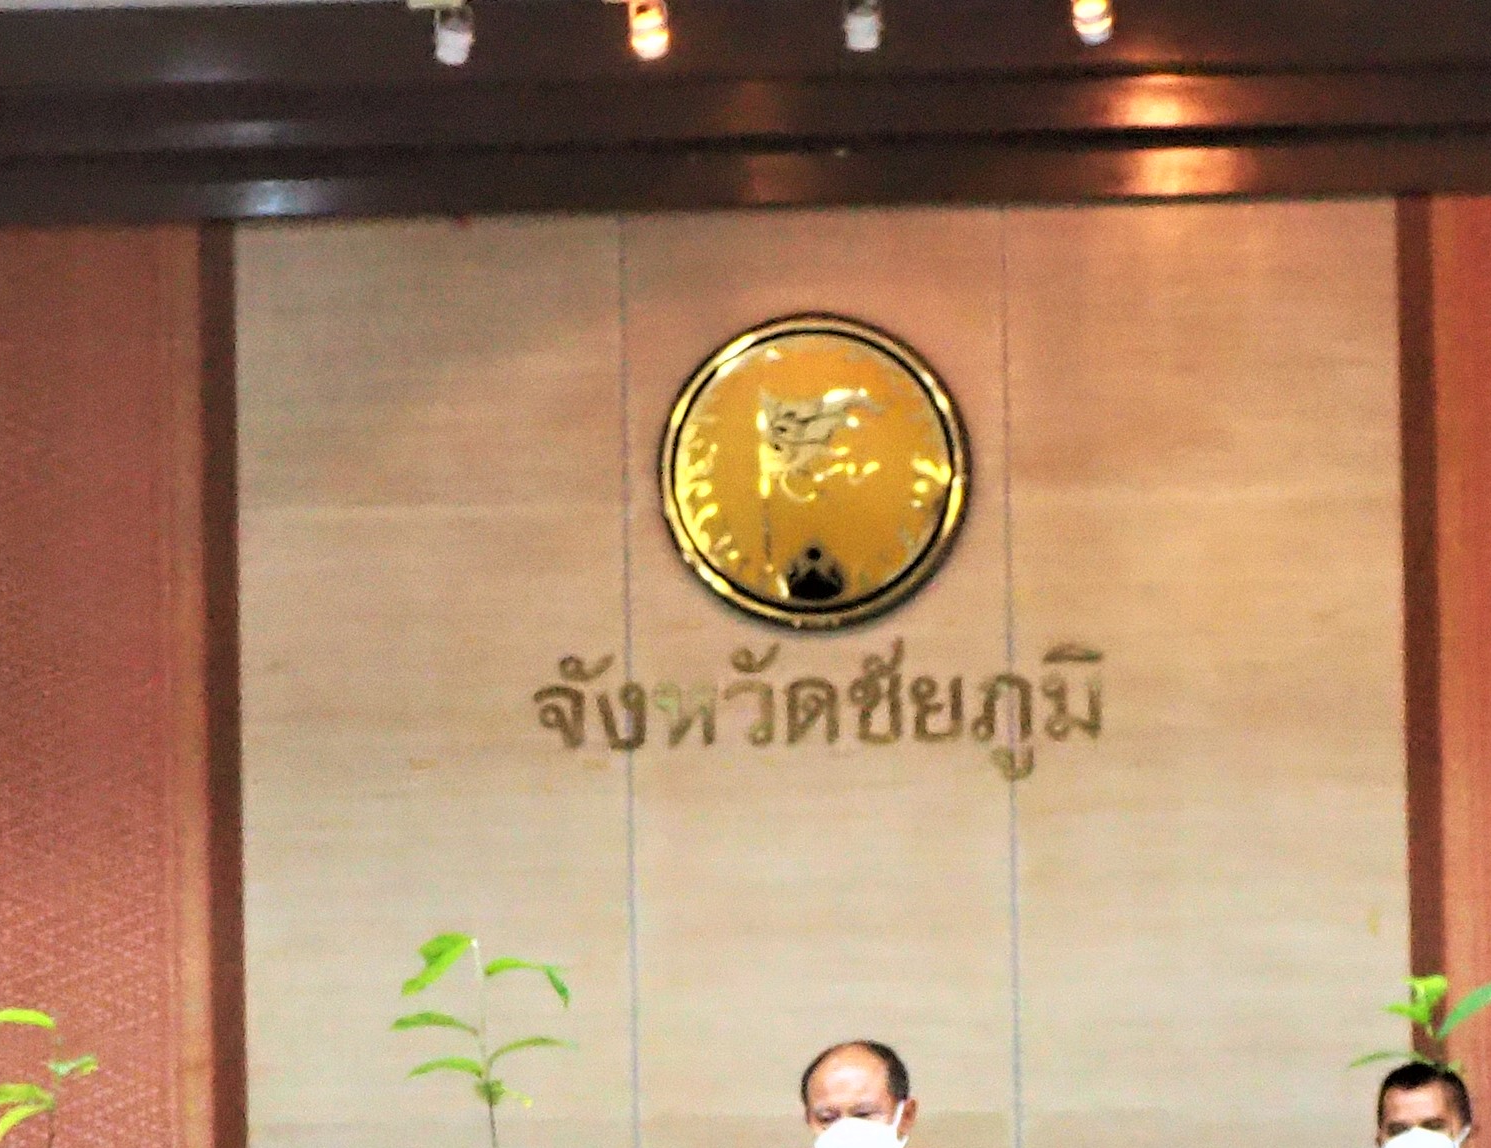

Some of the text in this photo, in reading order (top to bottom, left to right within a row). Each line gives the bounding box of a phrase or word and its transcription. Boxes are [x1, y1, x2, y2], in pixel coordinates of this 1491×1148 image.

[533, 637, 1104, 783] จังหวัดชัยภูมิ
